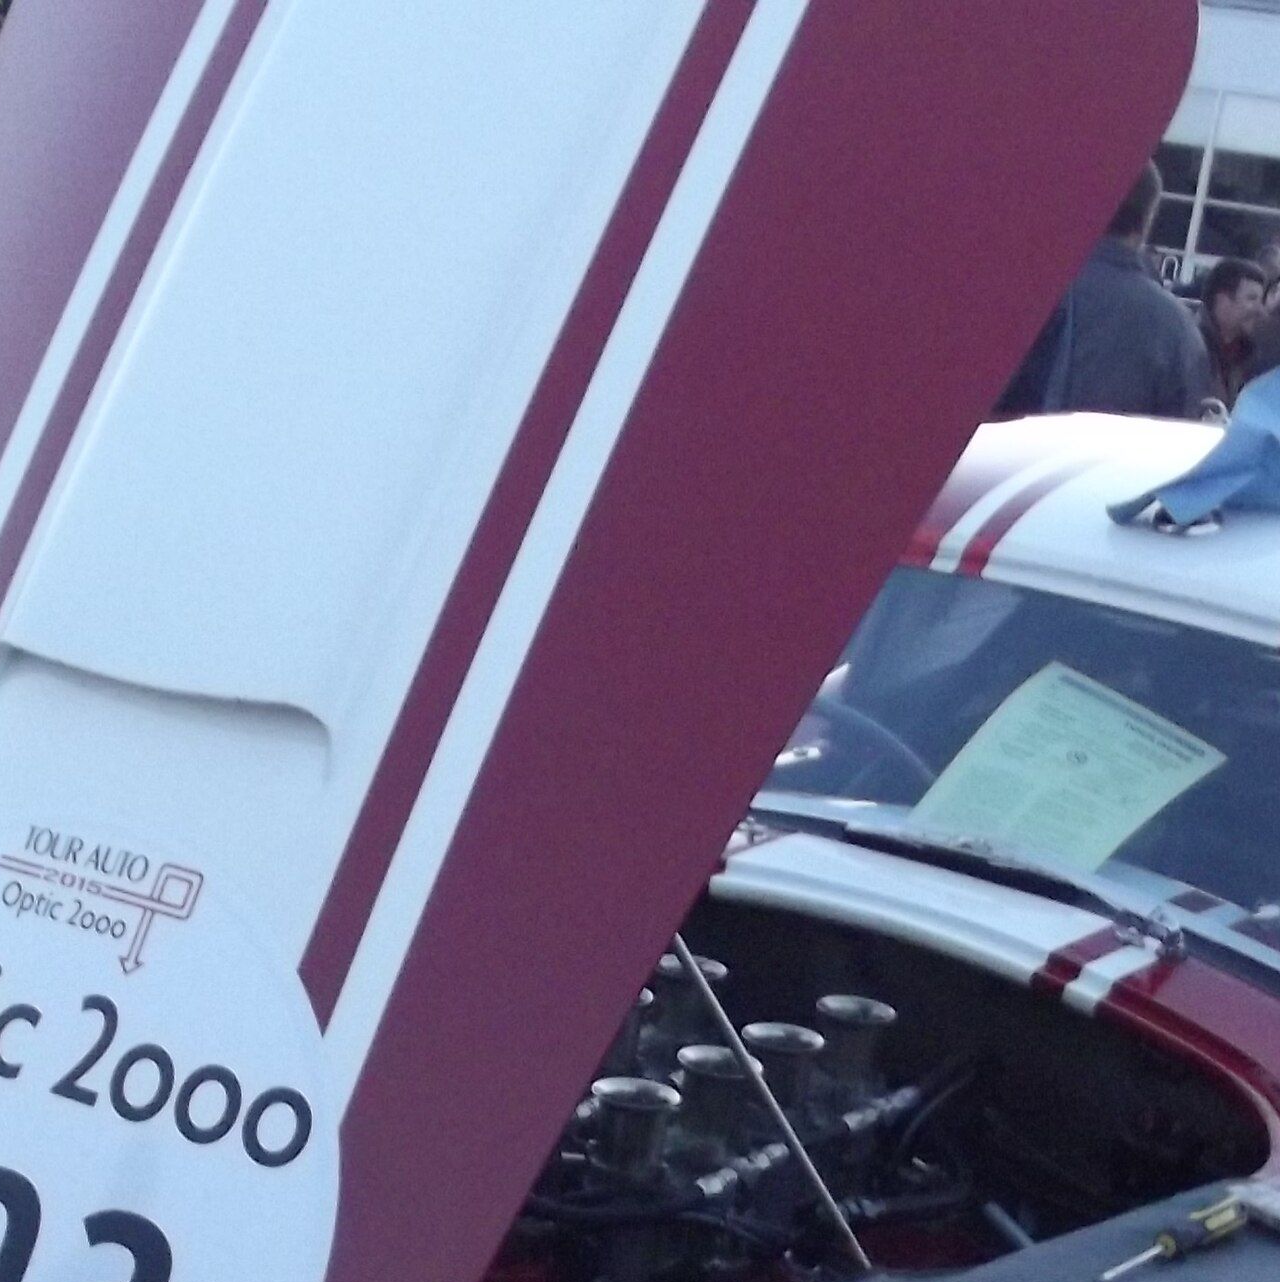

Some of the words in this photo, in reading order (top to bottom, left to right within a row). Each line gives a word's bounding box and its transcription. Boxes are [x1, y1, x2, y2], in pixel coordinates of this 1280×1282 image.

[24, 824, 84, 864] TOUR
[84, 843, 150, 883] AUTO
[42, 867, 104, 896] 2015
[1, 881, 64, 919] Optic
[67, 898, 128, 940] 2000
[50, 993, 314, 1168] 2000
